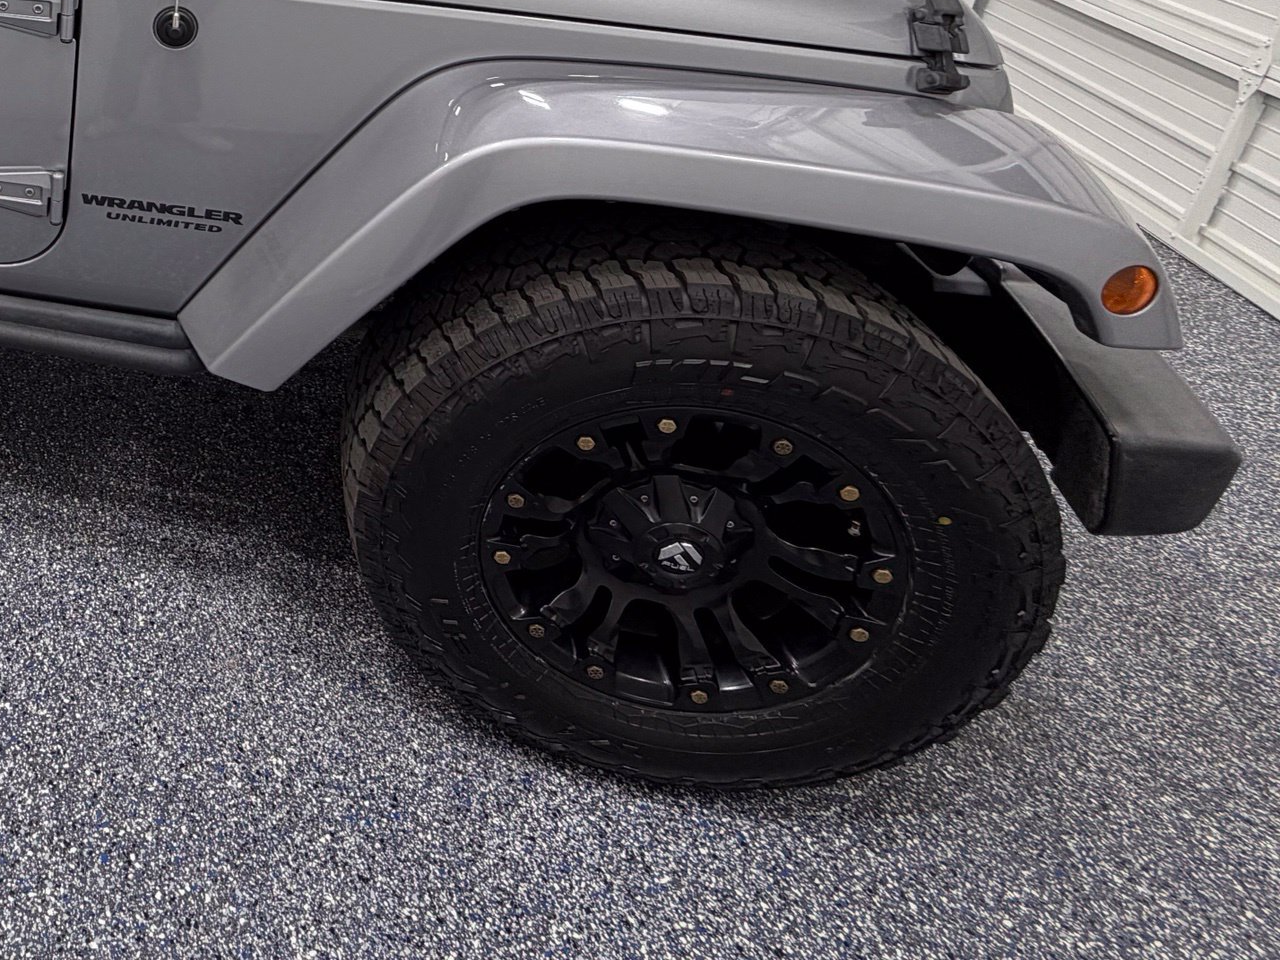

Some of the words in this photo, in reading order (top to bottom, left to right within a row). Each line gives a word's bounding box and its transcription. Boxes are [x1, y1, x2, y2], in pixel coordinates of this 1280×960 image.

[81, 193, 243, 225] WRANGLER
[106, 211, 222, 233] UNLIMITED
[660, 560, 695, 572] FUEL
